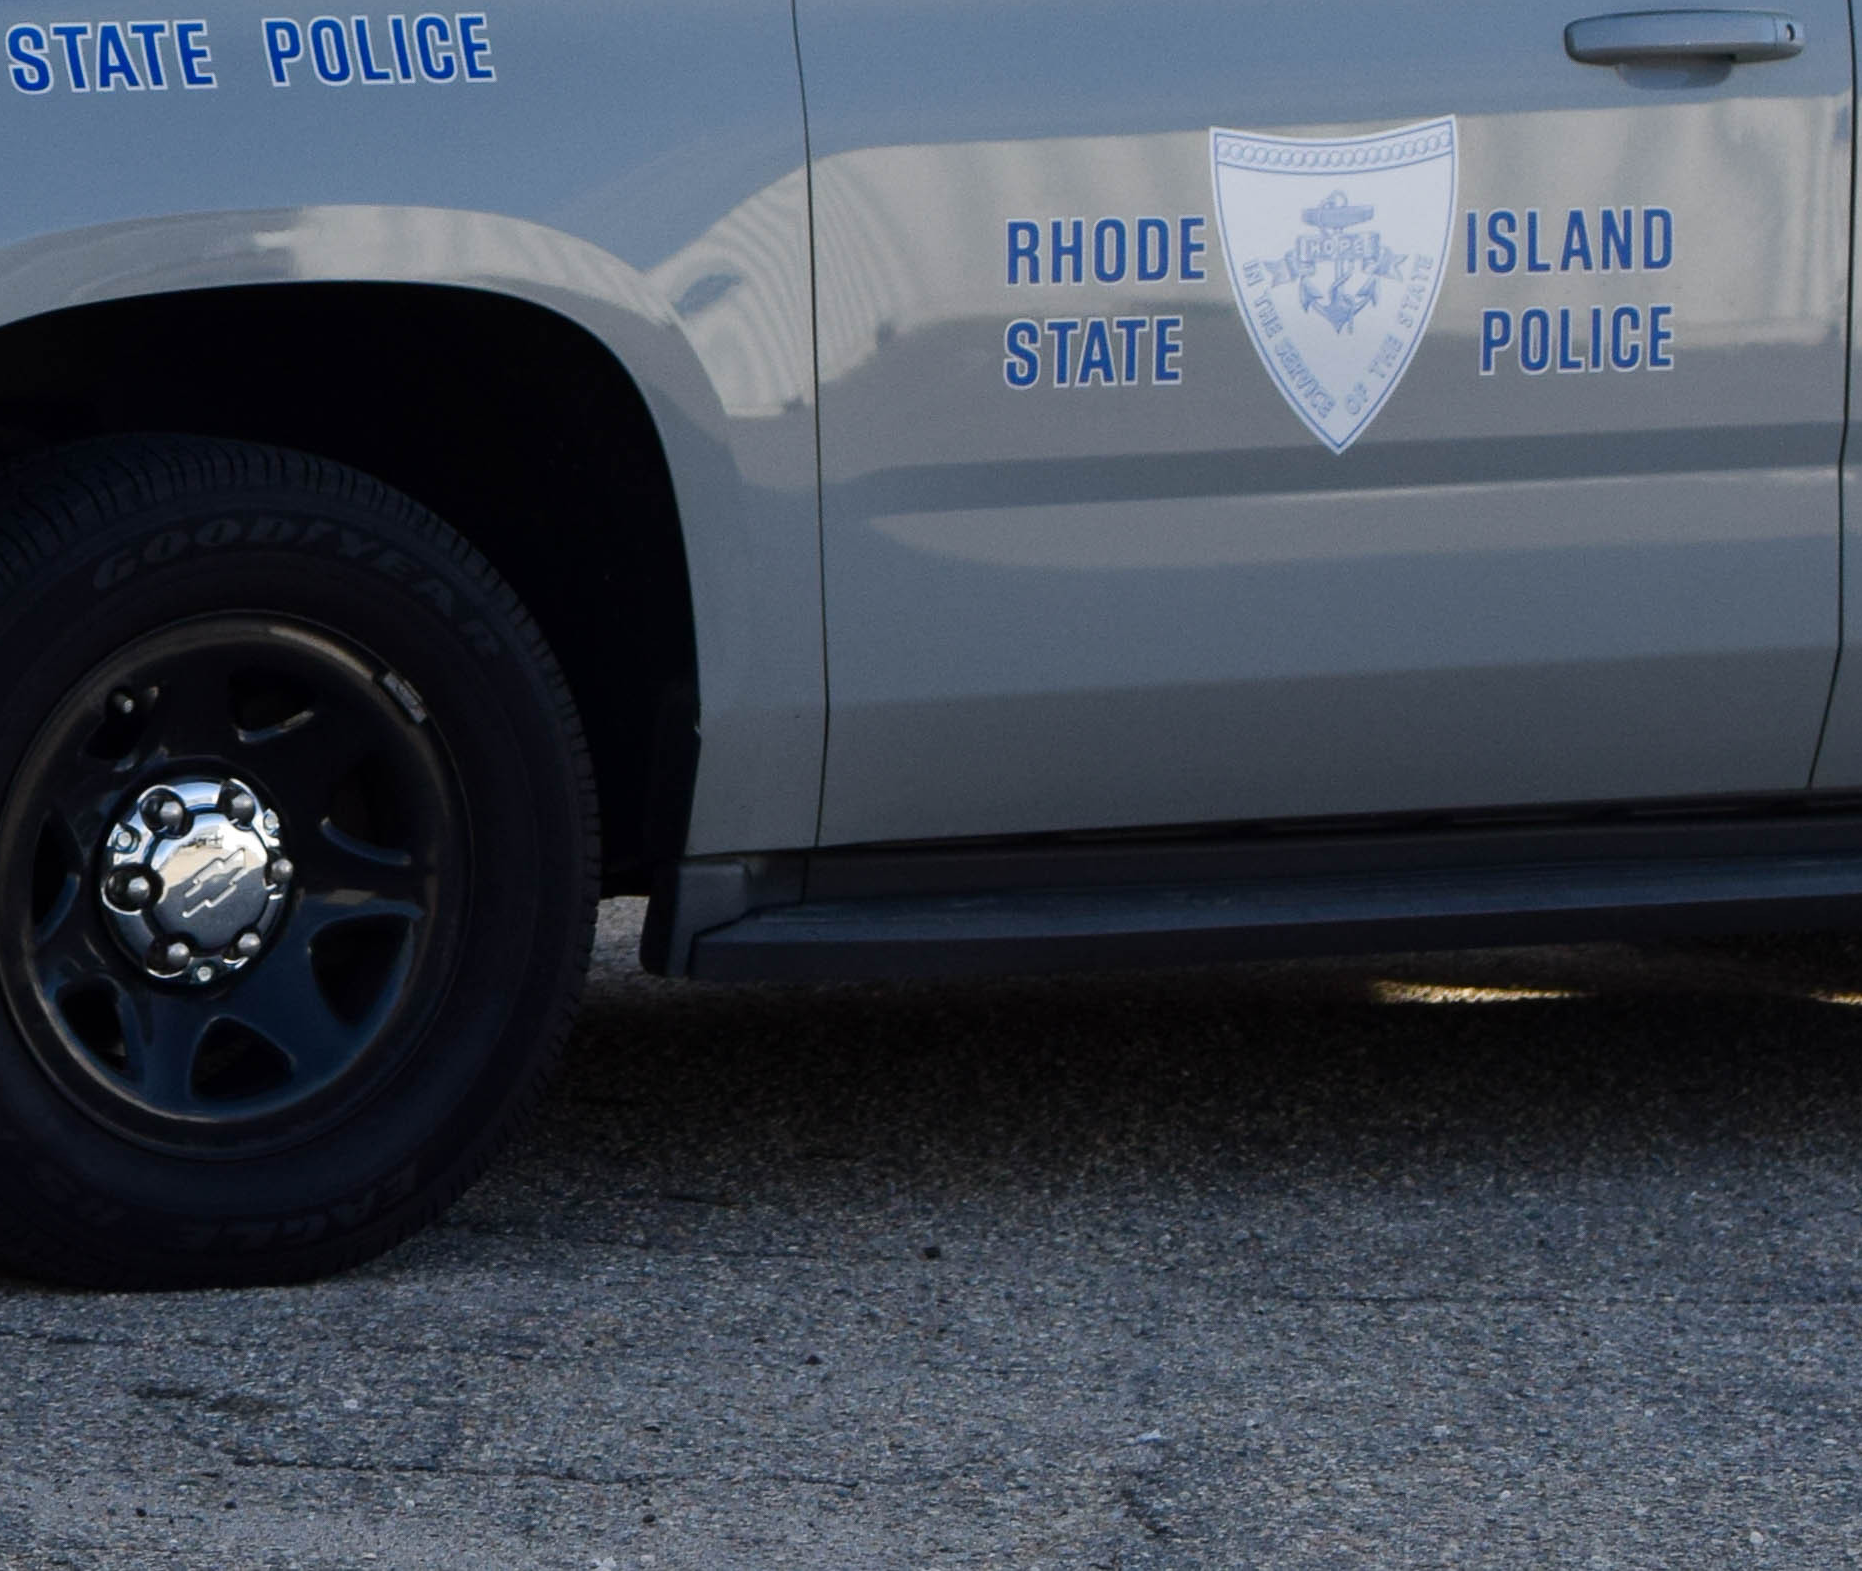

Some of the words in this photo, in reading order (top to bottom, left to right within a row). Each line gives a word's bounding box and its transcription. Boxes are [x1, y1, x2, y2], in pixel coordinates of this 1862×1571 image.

[5, 19, 217, 94] STATE
[260, 12, 497, 87] POLICE
[1005, 216, 1207, 285] RHODE
[1466, 206, 1674, 275] ISLAND
[1309, 237, 1366, 256] HOPE
[1004, 314, 1183, 390] STATE
[1478, 304, 1674, 376] POLICE
[1274, 337, 1337, 419] SERVICE
[1346, 382, 1369, 415] OF
[1368, 334, 1404, 379] THE
[1398, 254, 1434, 328] STATE
